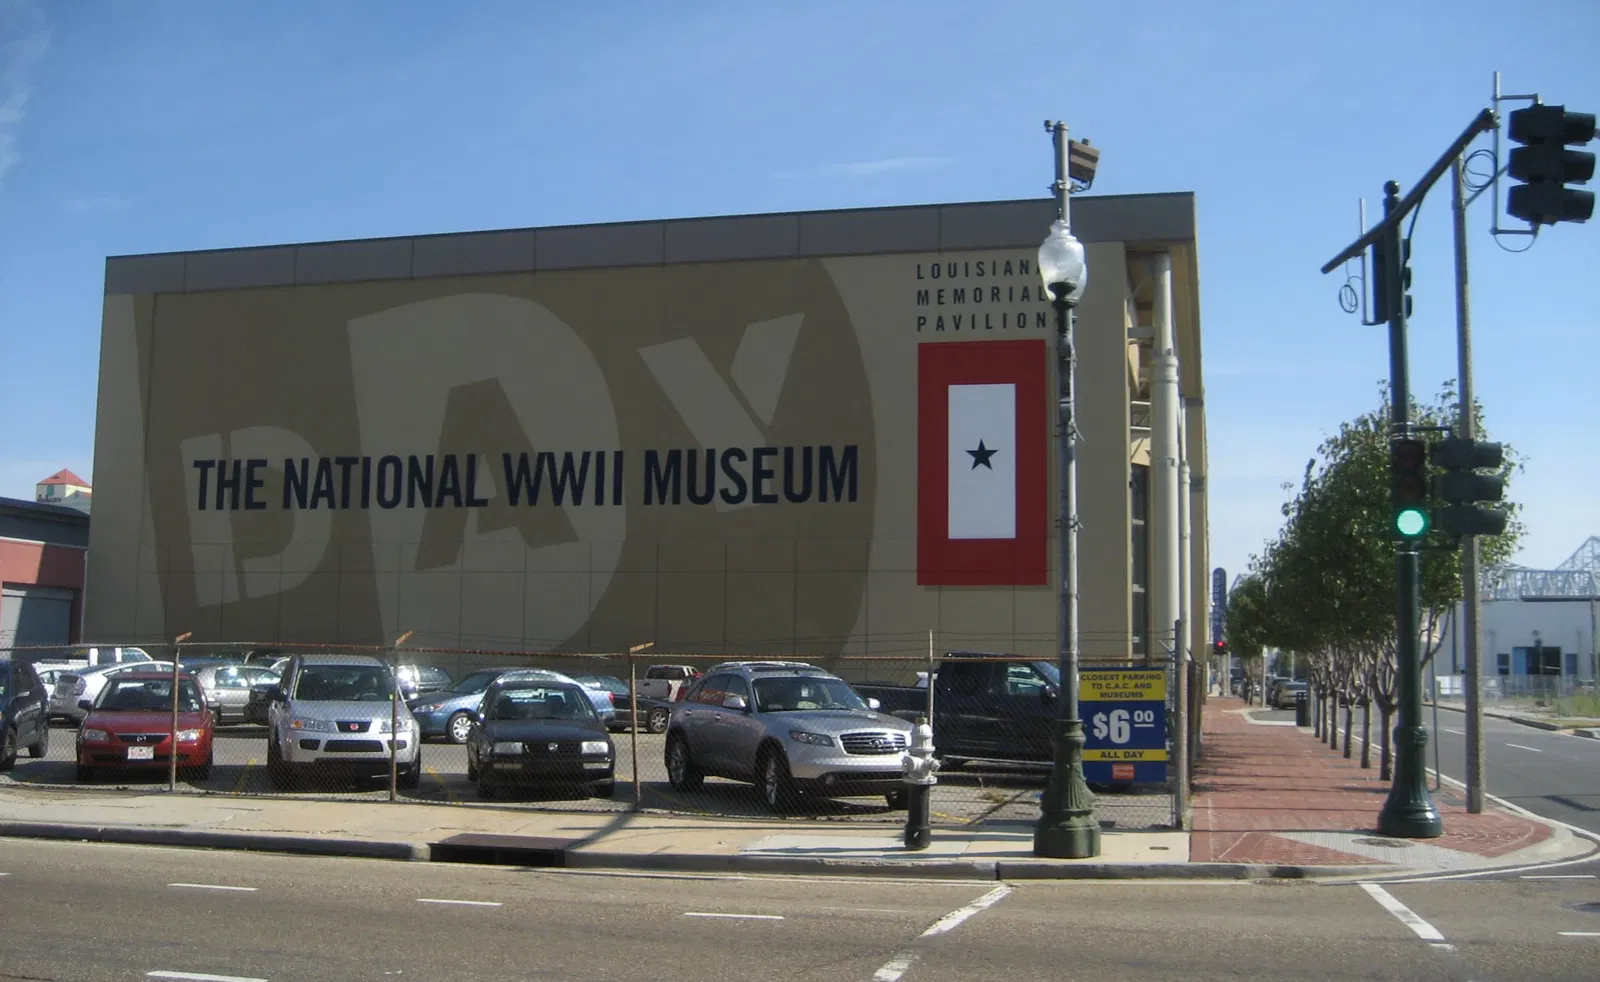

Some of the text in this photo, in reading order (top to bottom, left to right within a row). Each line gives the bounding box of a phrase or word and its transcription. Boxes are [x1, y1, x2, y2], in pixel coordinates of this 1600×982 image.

[917, 259, 1042, 280] LOUISIAN
[917, 286, 1046, 306] MEMORIAL
[917, 312, 1047, 332] PAVILION
[194, 445, 859, 510] THE NATIONAL WWII MUSEUM
[1080, 673, 1162, 681] CLOSEST PARKING
[1100, 751, 1144, 759] ALL DAY
